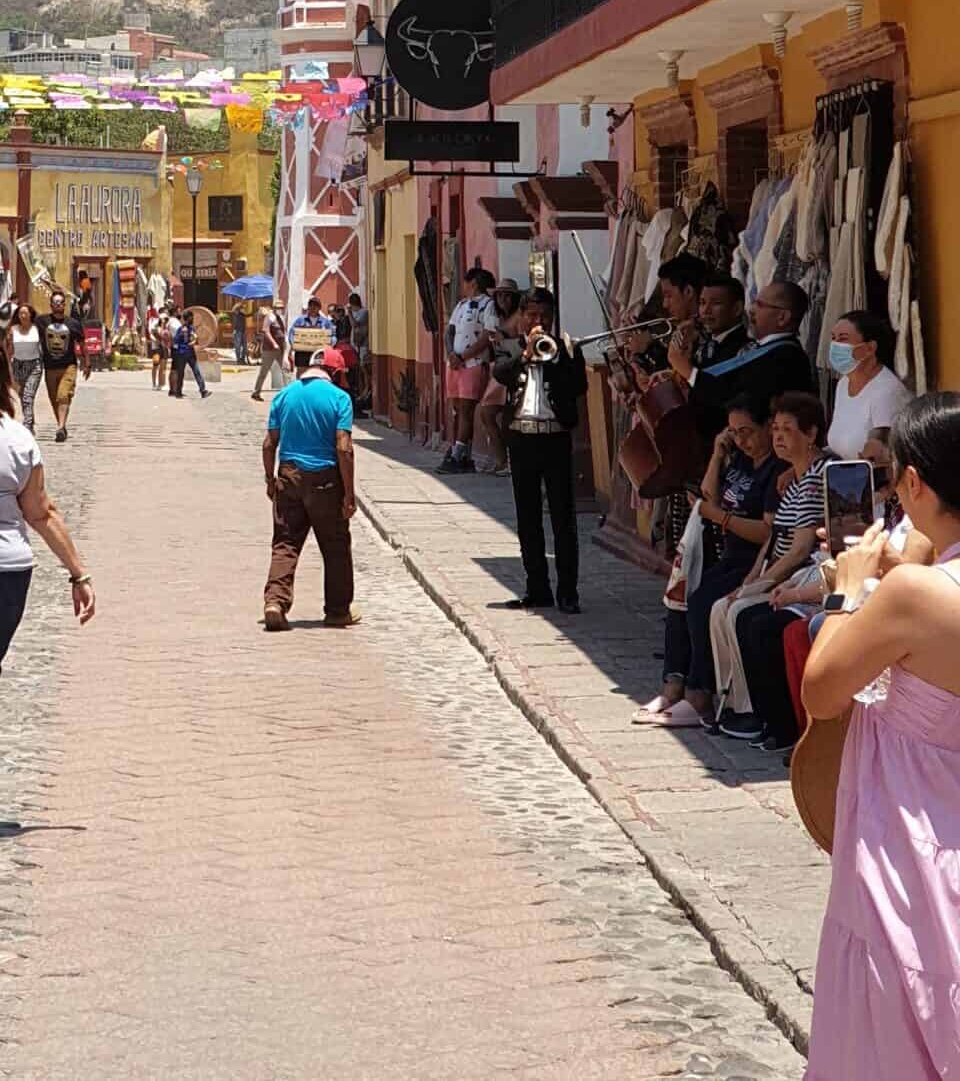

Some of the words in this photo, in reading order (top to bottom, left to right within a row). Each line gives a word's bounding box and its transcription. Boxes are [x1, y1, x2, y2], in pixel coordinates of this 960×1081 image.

[55, 182, 77, 223] LA
[80, 183, 142, 224] AURORA
[92, 229, 157, 250] ARTESANAL
